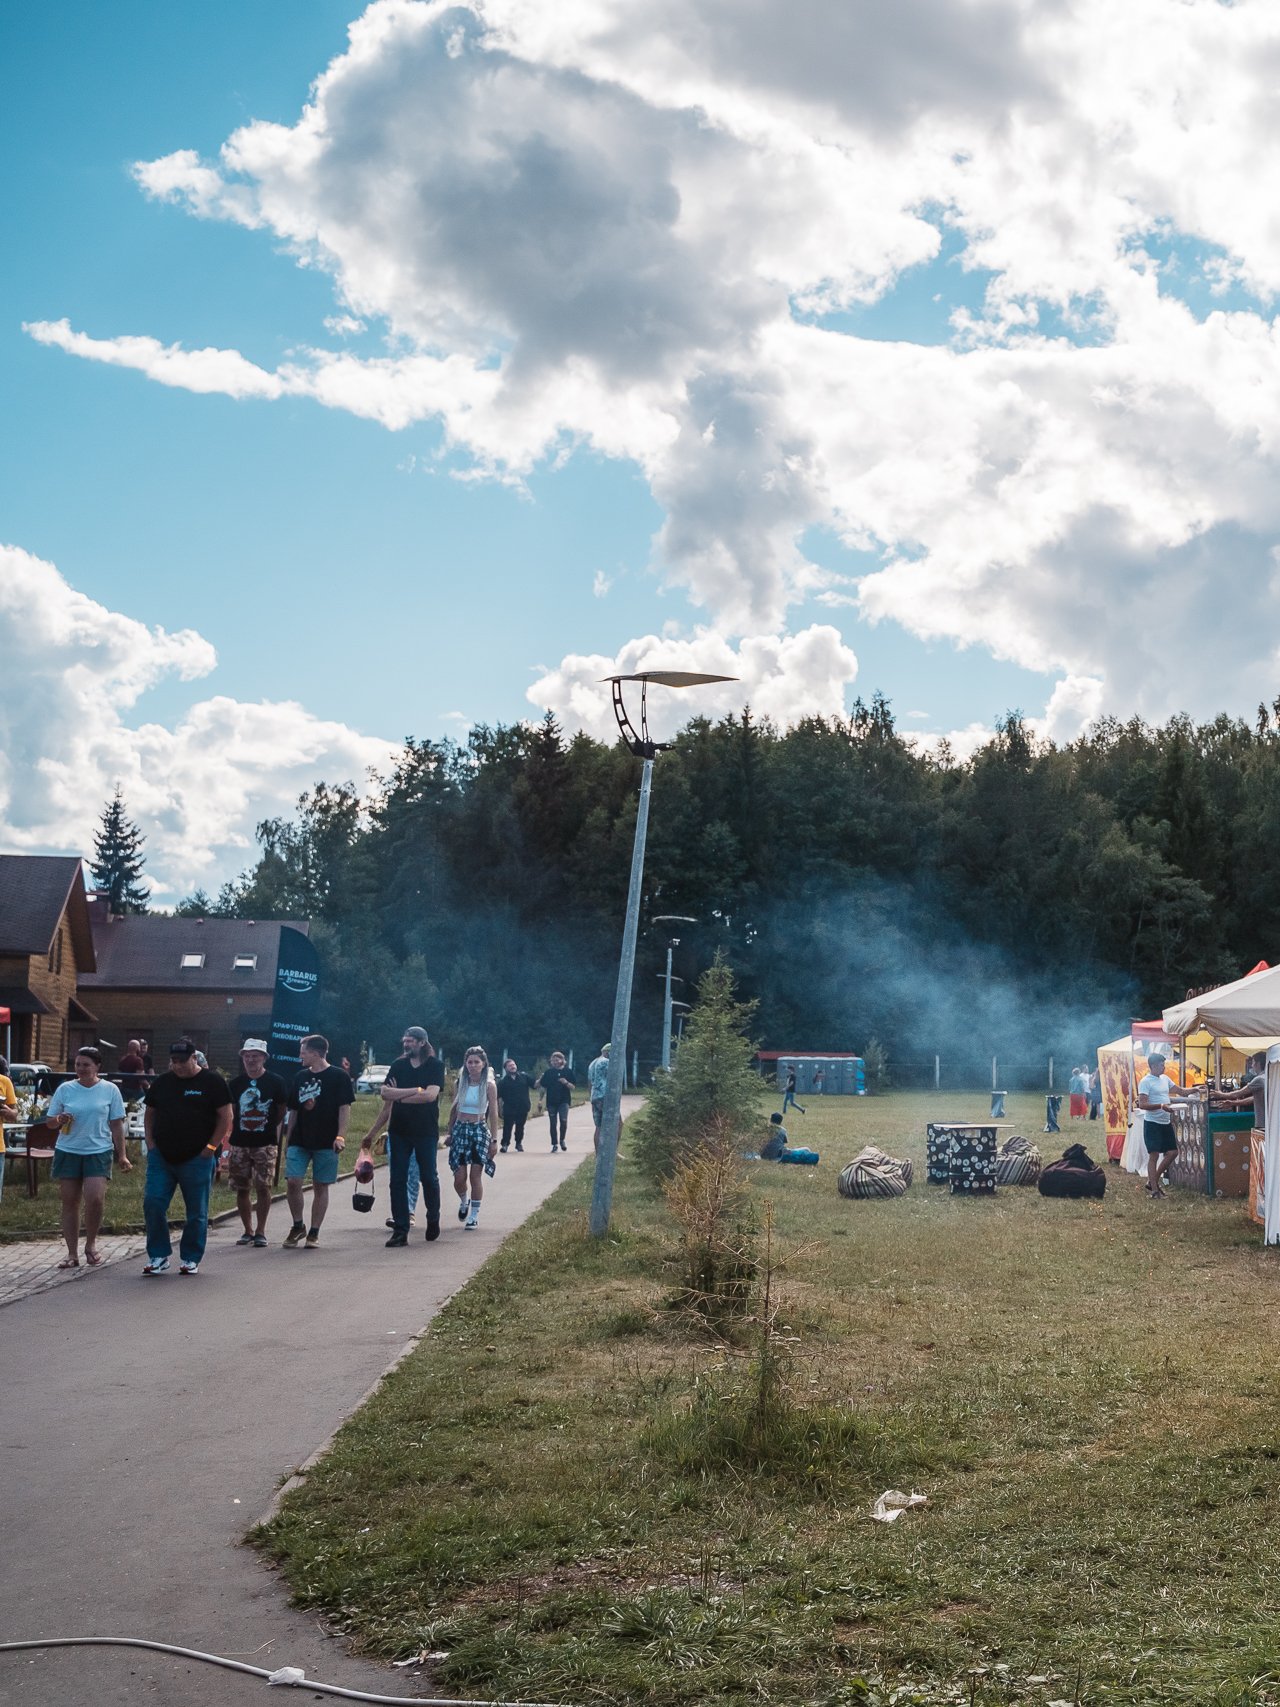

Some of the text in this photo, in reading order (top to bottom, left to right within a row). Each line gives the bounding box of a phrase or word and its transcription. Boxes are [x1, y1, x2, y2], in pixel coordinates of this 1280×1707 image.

[278, 968, 317, 982] BARBARUS
[286, 976, 310, 986] Brewery
[273, 1021, 310, 1032] КРАФТОВАЯ
[272, 1031, 303, 1041] ПИВОВАР
